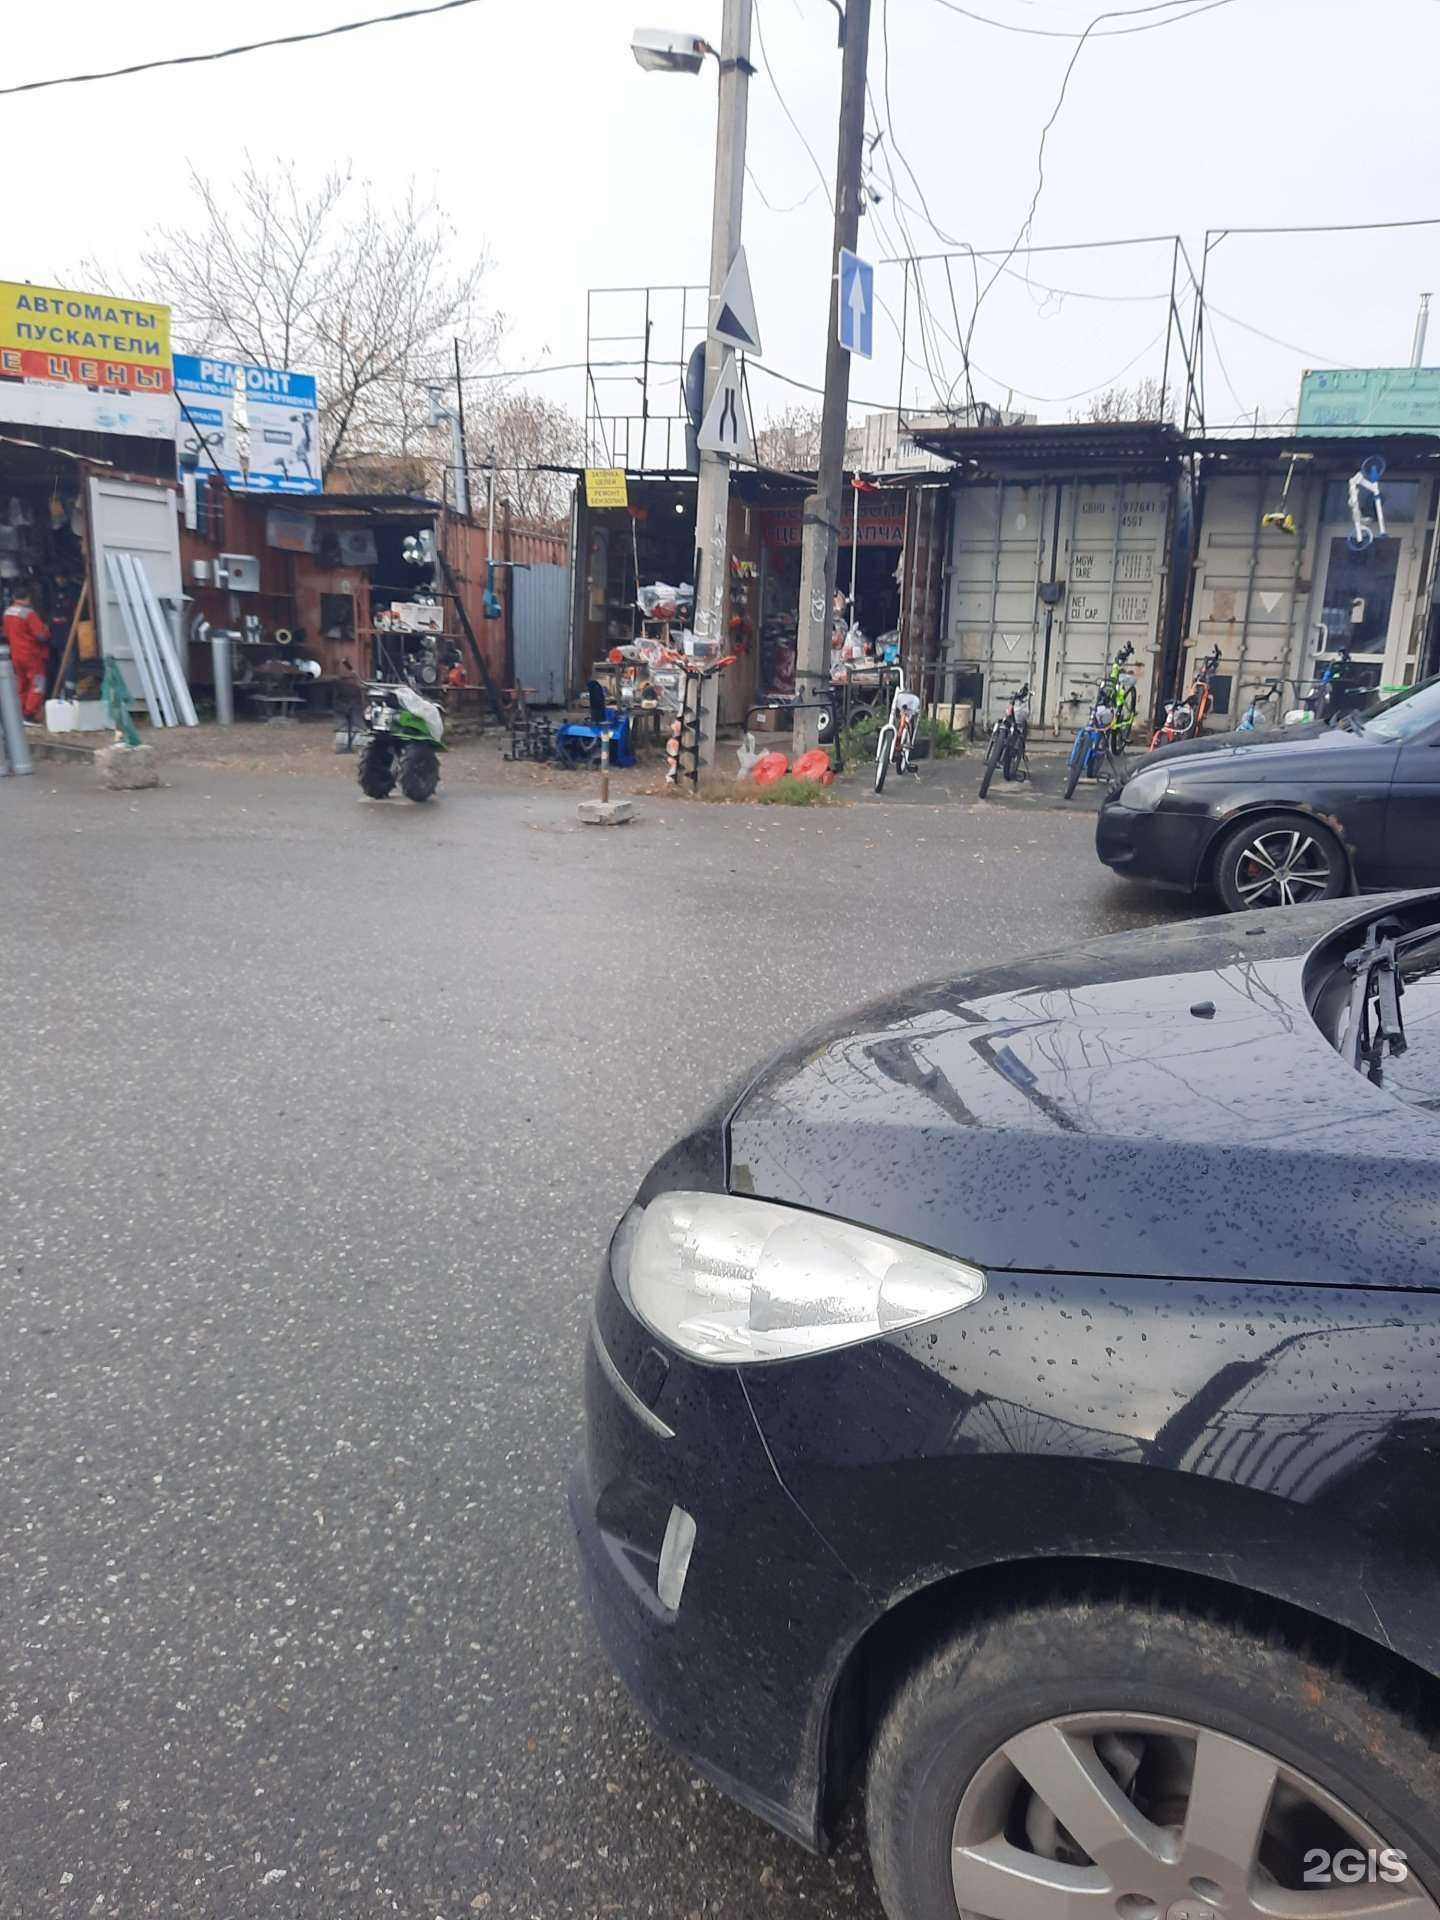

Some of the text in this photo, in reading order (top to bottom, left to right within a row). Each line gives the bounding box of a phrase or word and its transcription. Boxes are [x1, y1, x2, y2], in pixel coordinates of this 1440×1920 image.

[16, 294, 156, 329] АВТОМАТЫ
[16, 322, 160, 356] ПУСКАТЕЛИ
[48, 356, 163, 389] ЦЕНЫ
[1072, 597, 1087, 607] NET
[1085, 608, 1098, 619] CAP
